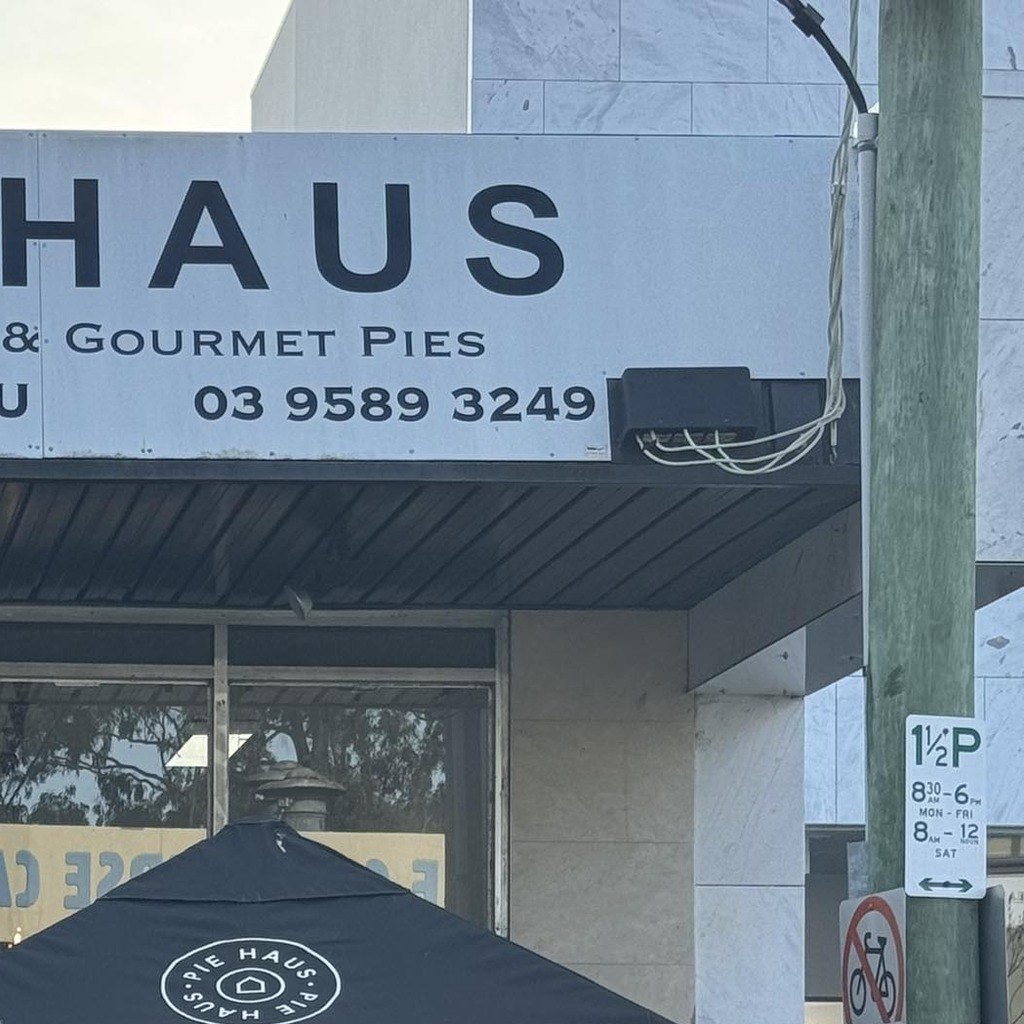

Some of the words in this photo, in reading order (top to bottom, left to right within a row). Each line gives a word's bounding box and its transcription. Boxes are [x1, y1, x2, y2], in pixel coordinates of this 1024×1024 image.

[0, 177, 565, 297] HAUS
[2, 322, 39, 353] &
[194, 385, 265, 421] 03
[286, 386, 430, 422] 9589
[451, 386, 596, 423] 3249
[919, 808, 943, 818] MON
[935, 849, 957, 858] SAT
[183, 955, 225, 981] PIE
[240, 948, 317, 979] HAUS
[183, 992, 259, 1020] HAUS
[275, 992, 318, 1016] PIE
